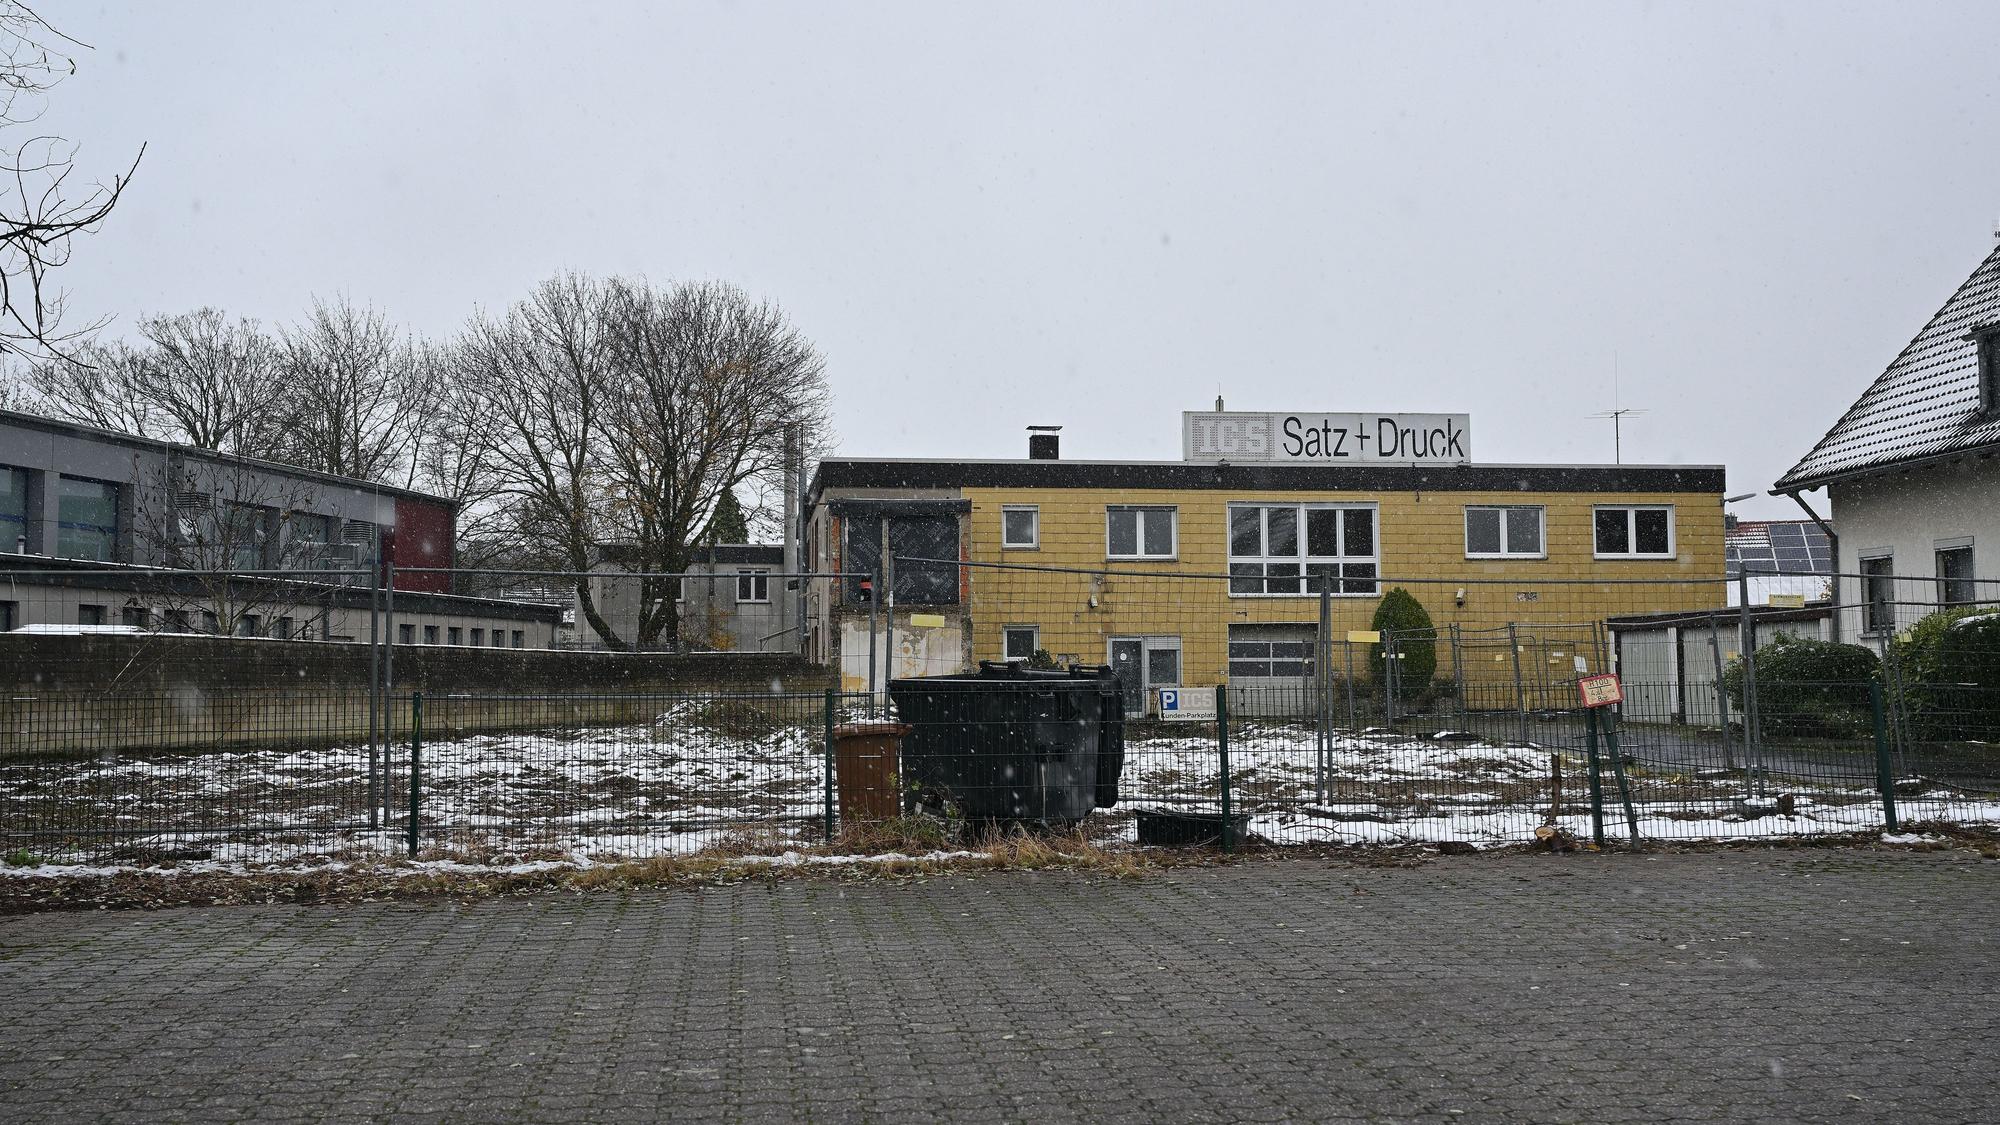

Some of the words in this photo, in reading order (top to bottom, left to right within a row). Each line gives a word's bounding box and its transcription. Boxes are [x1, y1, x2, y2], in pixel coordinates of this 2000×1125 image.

[1197, 419, 1266, 454] ICS
[1283, 416, 1349, 457] Satz
[1355, 422, 1371, 451] +
[1378, 418, 1465, 457] Druck
[1163, 692, 1176, 709] P
[1183, 693, 1213, 708] ICS
